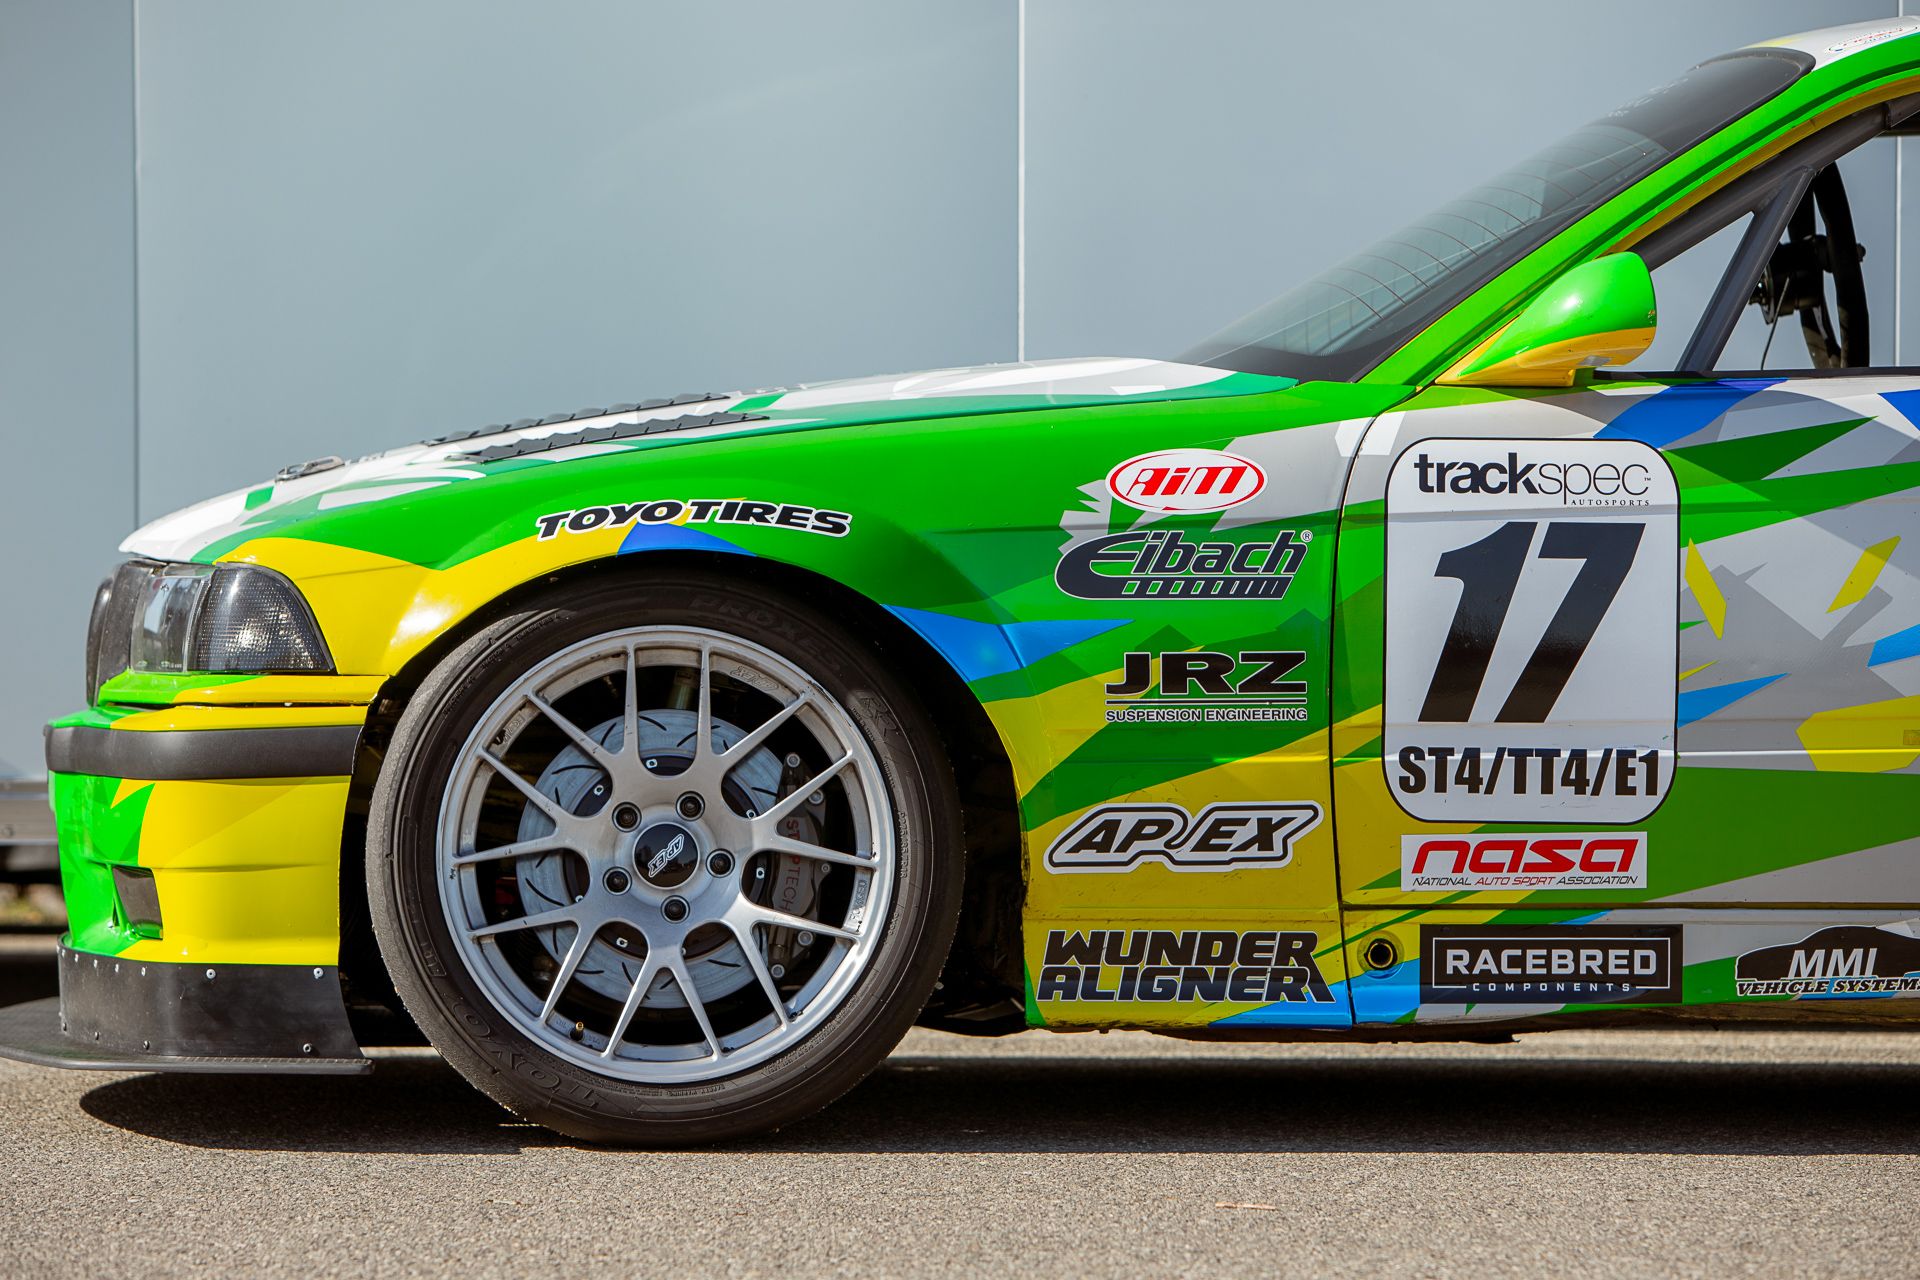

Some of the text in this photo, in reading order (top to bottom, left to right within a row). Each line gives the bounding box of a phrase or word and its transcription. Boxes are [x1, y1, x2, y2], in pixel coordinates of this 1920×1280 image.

[1414, 452, 1650, 505] trackspec
[537, 500, 853, 541] TOYO TIRES
[1570, 499, 1650, 507] AUTOSPORTS
[1054, 530, 1308, 600] Eibach
[1417, 521, 1647, 723] 17
[1105, 651, 1307, 695] JRZ
[1105, 708, 1307, 722] SUSPENSION ENGINEERING
[1398, 746, 1659, 796] ST4/TT4/E1
[1063, 816, 1301, 854] APEX
[1412, 875, 1639, 887] NATIONAL AUTO SPORT ASSOCIATION
[1043, 929, 1318, 967] WUNDER
[1446, 949, 1657, 975] RACEBRED
[1787, 948, 1878, 979] MMI
[1036, 965, 1336, 1003] ALIGNER
[1472, 982, 1631, 992] COMPONENTS
[1736, 979, 1830, 997] VEHICLE
